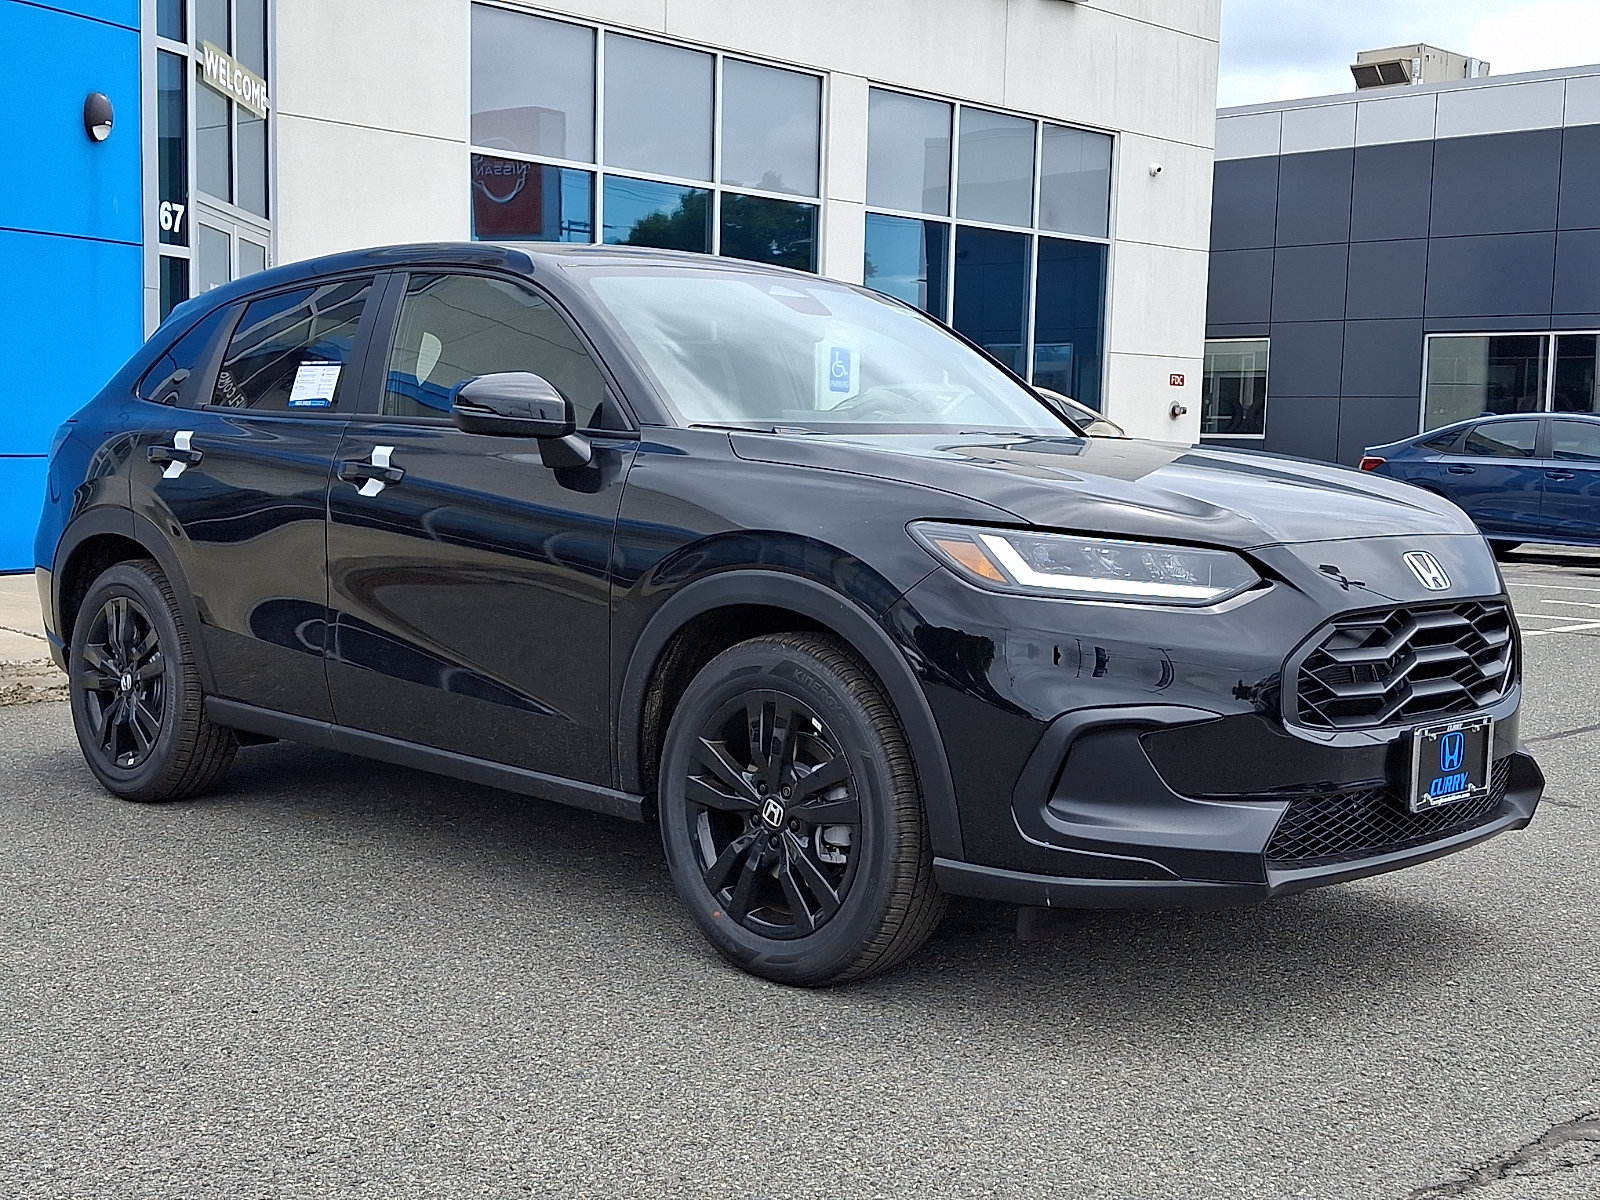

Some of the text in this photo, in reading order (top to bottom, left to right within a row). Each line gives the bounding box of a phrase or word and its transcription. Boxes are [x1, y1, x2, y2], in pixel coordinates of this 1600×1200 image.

[203, 46, 266, 112] WELCOME
[159, 200, 185, 233] 67
[1171, 375, 1183, 385] FDC
[1430, 771, 1469, 797] CURRY
